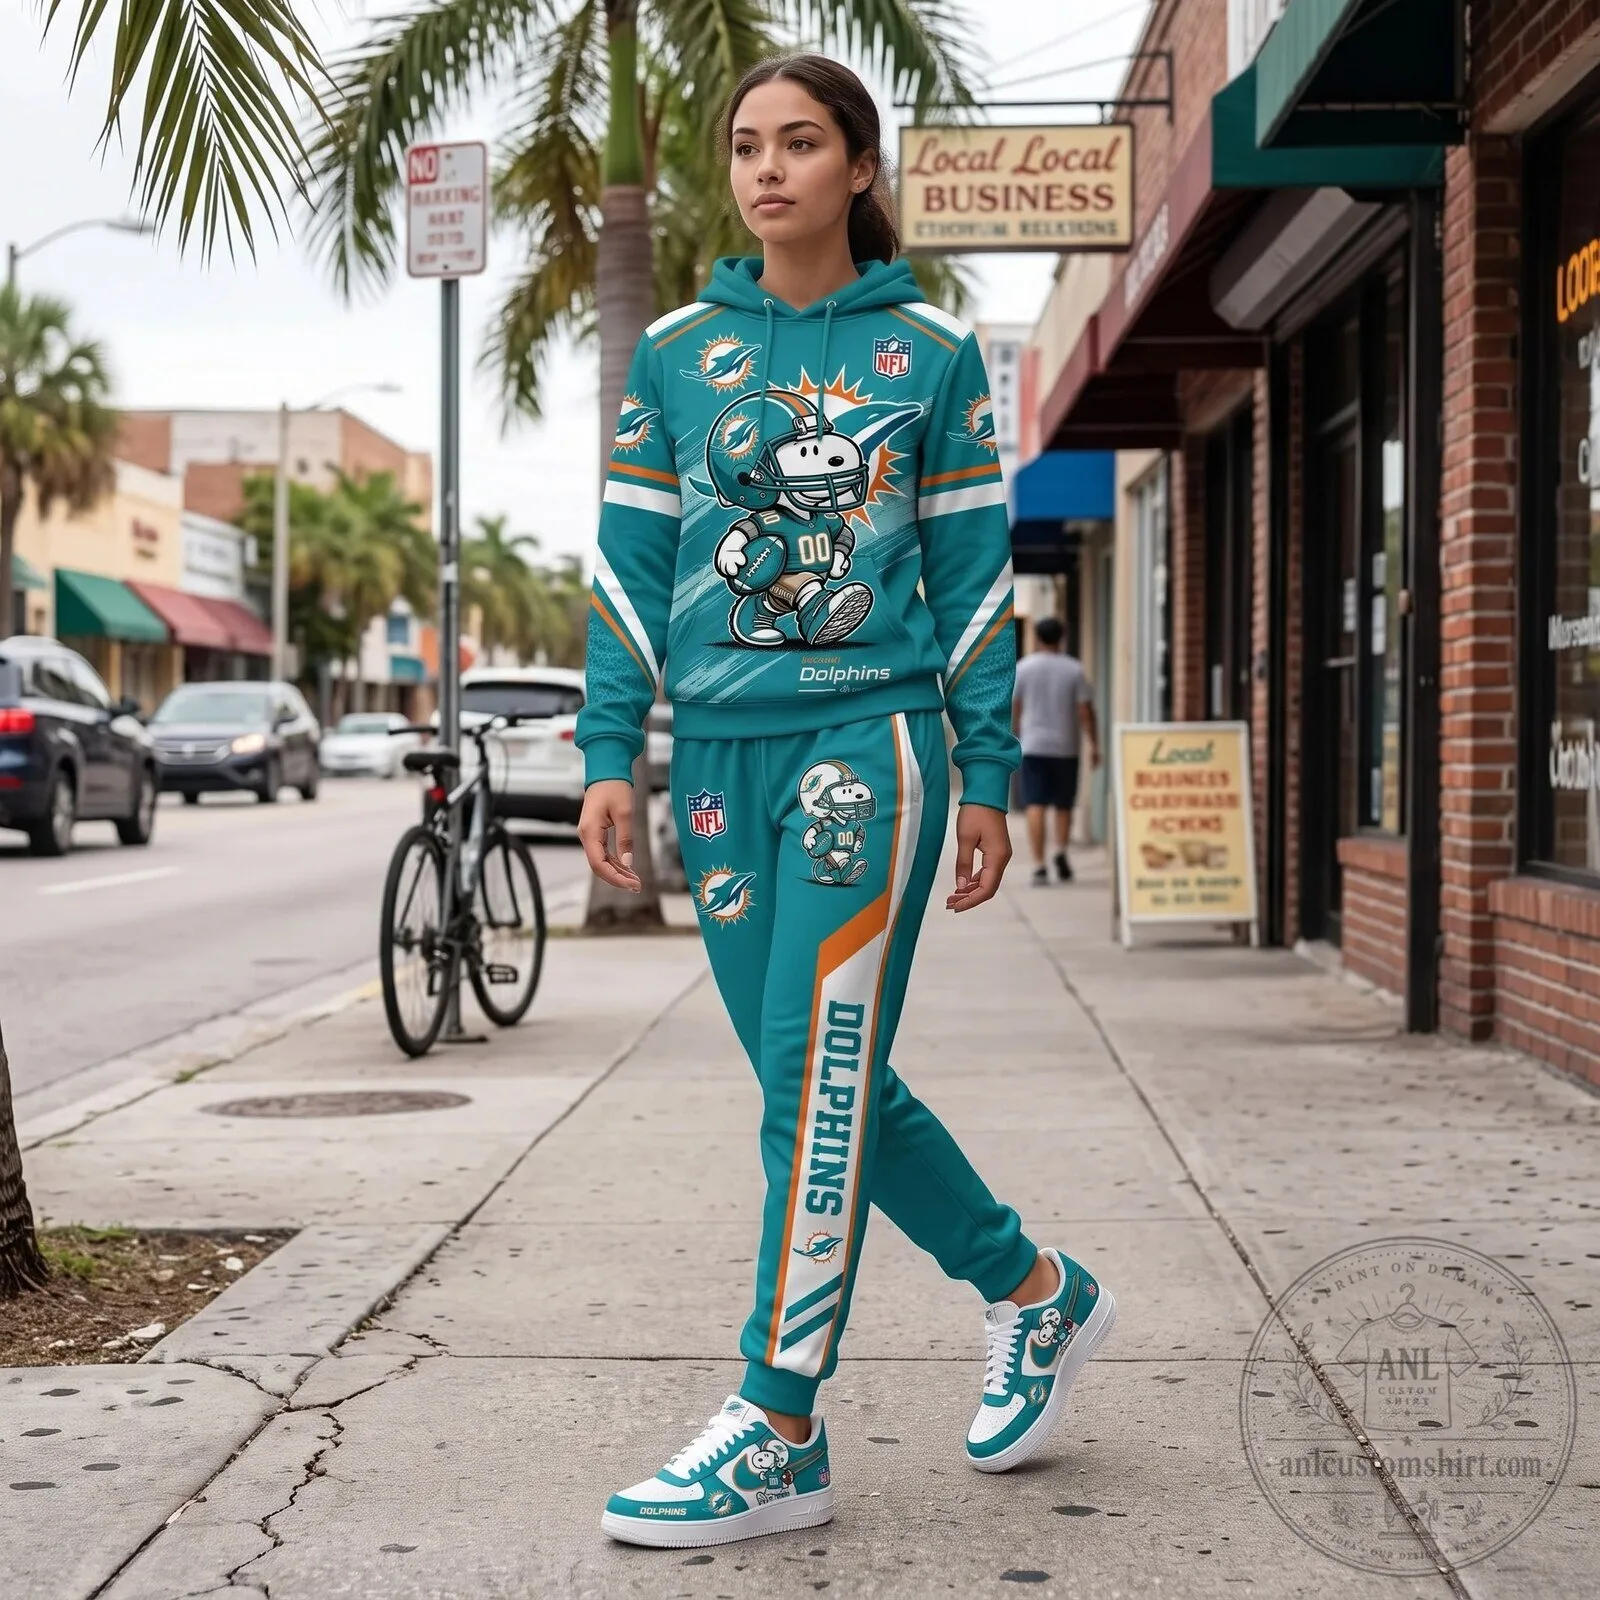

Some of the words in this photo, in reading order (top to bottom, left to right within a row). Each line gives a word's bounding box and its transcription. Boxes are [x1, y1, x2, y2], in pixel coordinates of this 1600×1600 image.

[410, 150, 438, 181] NO
[907, 134, 1008, 177] Local
[1011, 134, 1122, 176] Local
[922, 183, 1115, 213] BUSINESS
[877, 353, 907, 376] NFL
[798, 532, 830, 565] 00
[800, 665, 891, 685] Dolphins
[693, 810, 724, 835] NFL
[838, 831, 854, 846] 00
[805, 1000, 865, 1216] DOLPHINS
[640, 1507, 688, 1516] DOLPHINS
